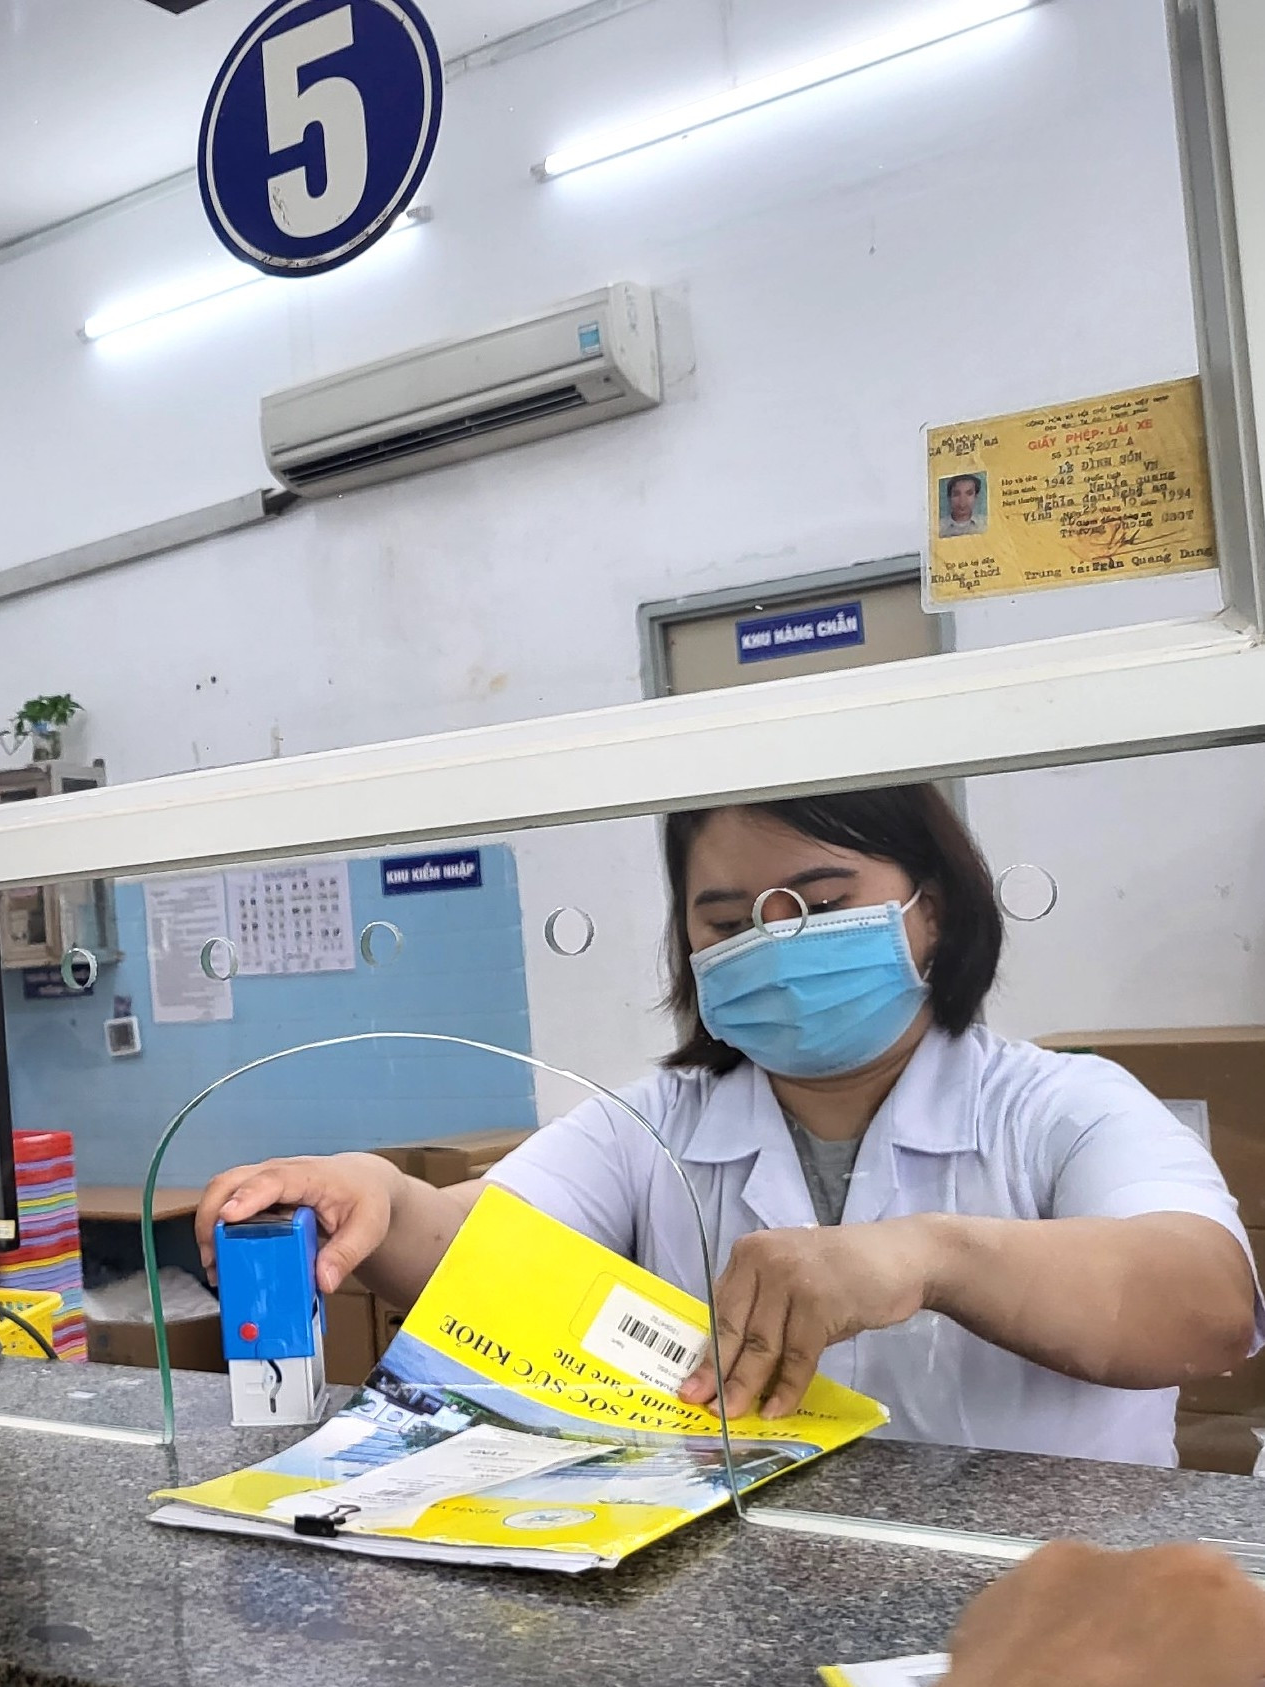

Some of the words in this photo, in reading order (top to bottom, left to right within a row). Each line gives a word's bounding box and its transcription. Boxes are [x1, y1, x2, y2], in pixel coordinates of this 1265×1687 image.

[262, 4, 368, 239] 5
[1028, 433, 1057, 451] GIẤY
[1066, 427, 1101, 444] PHÉP
[1108, 421, 1129, 436] LÁI
[1136, 418, 1154, 431] XE
[1044, 475, 1075, 489] 1942
[1161, 488, 1192, 502] 1994
[1024, 569, 1062, 581] Trung
[741, 630, 772, 650] KHU
[386, 869, 410, 884] KHU
[443, 860, 475, 880] NHẬP
[439, 1314, 512, 1367] KHỎE
[513, 1358, 568, 1394] SỨC
[553, 1348, 587, 1376] File
[590, 1369, 635, 1398] Care
[567, 1388, 624, 1417] SÓC
[641, 1394, 703, 1421] Health
